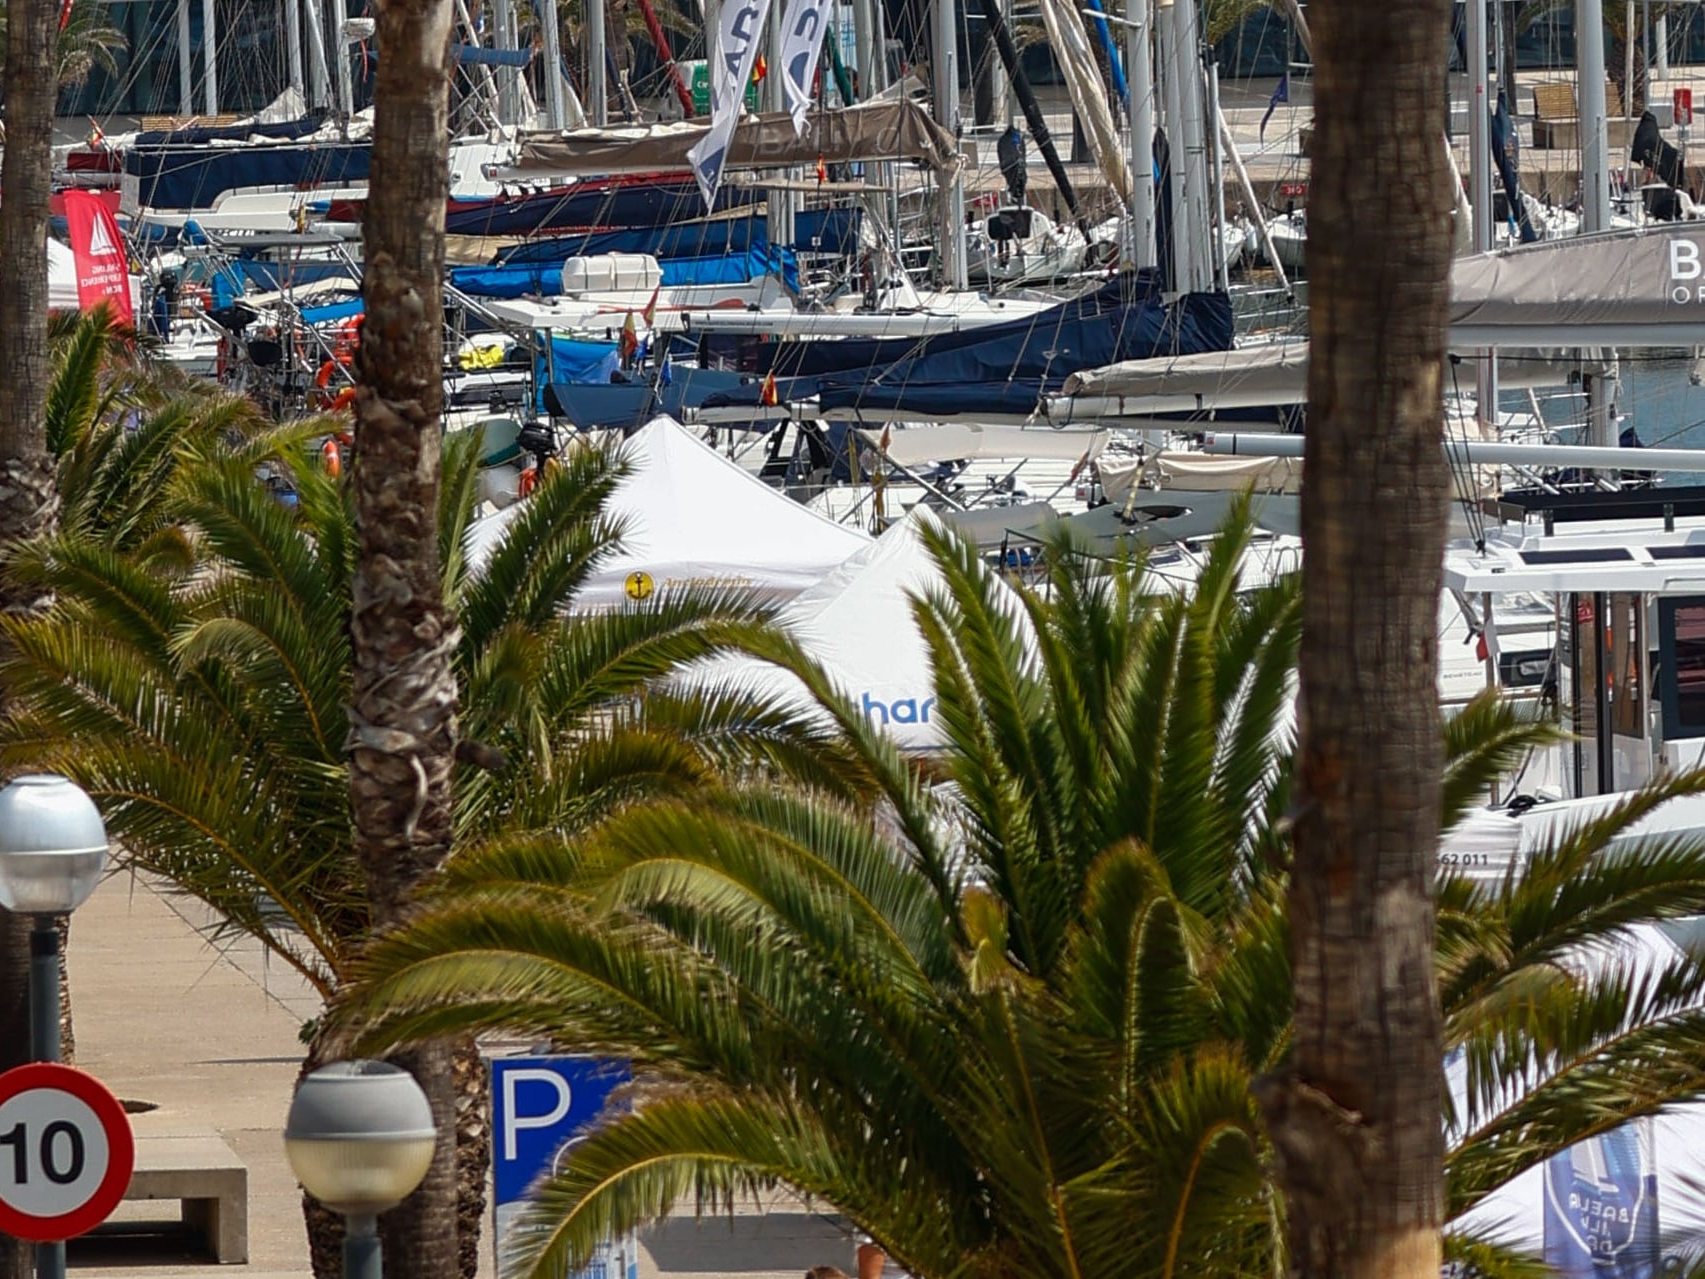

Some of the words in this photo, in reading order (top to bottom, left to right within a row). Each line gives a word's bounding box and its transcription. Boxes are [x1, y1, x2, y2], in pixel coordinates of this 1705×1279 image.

[1670, 240, 1705, 279] B
[860, 691, 935, 725] har
[1438, 853, 1459, 866] 62
[1462, 853, 1489, 866] 011
[502, 1068, 572, 1163] P
